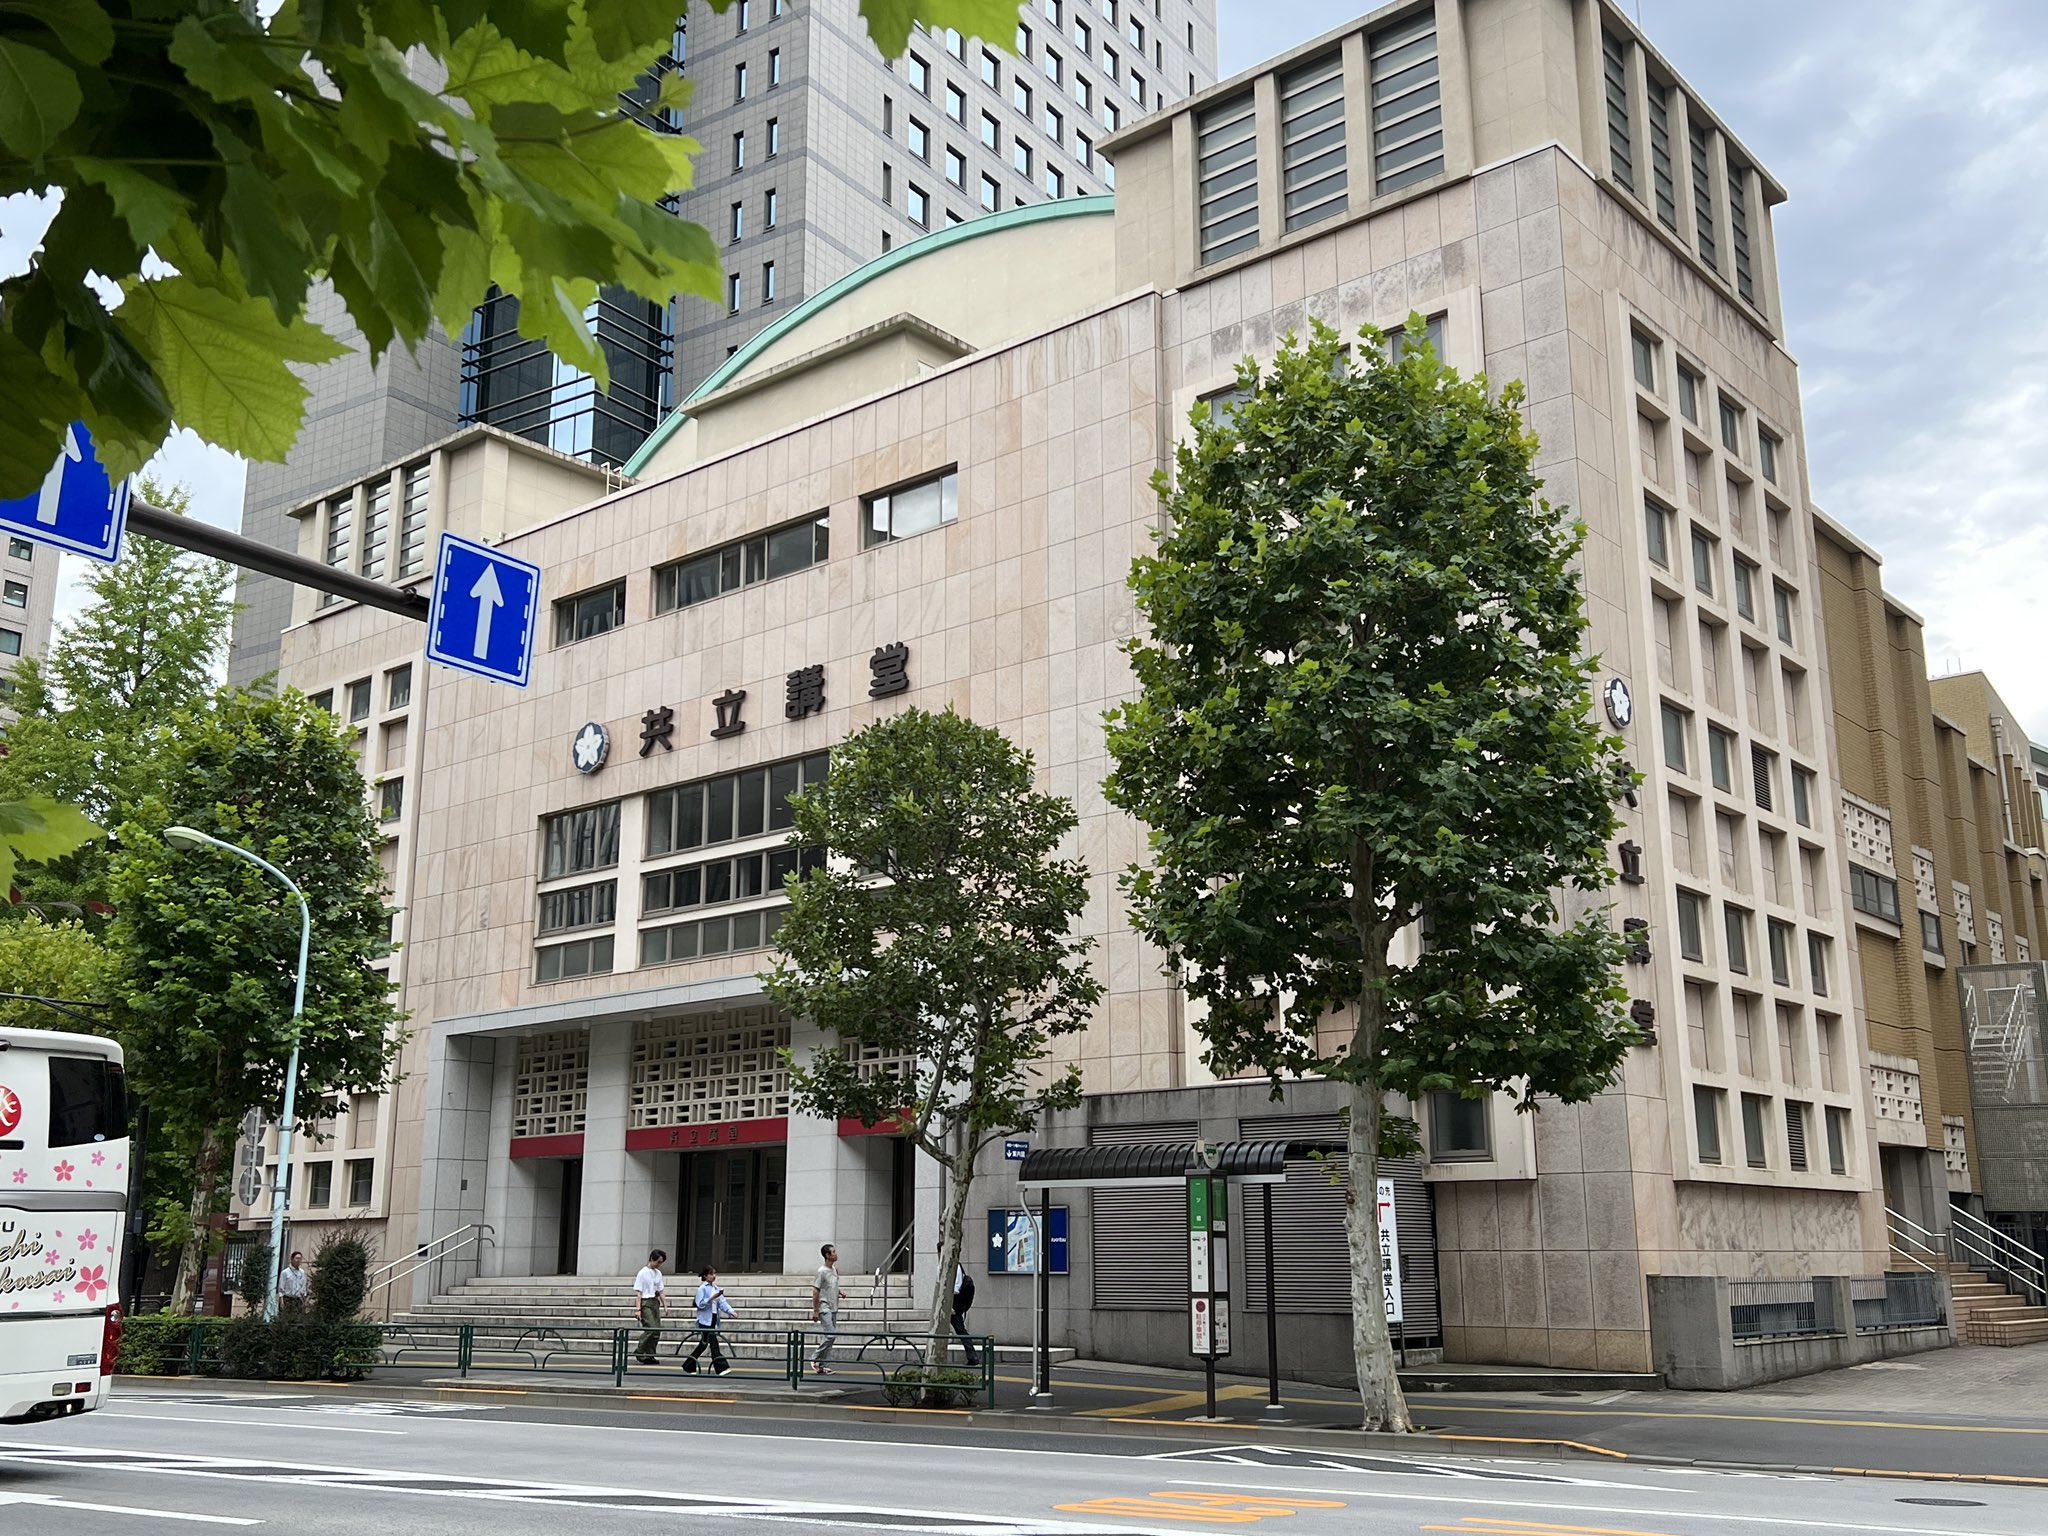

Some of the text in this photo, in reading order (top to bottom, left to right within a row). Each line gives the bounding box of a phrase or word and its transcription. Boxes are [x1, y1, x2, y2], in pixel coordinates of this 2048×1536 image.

[639, 641, 910, 758] 共立講堂
[1377, 1186, 1391, 1196] の先
[0, 1221, 15, 1232] U
[1380, 1229, 1395, 1316] 共立講堂入口
